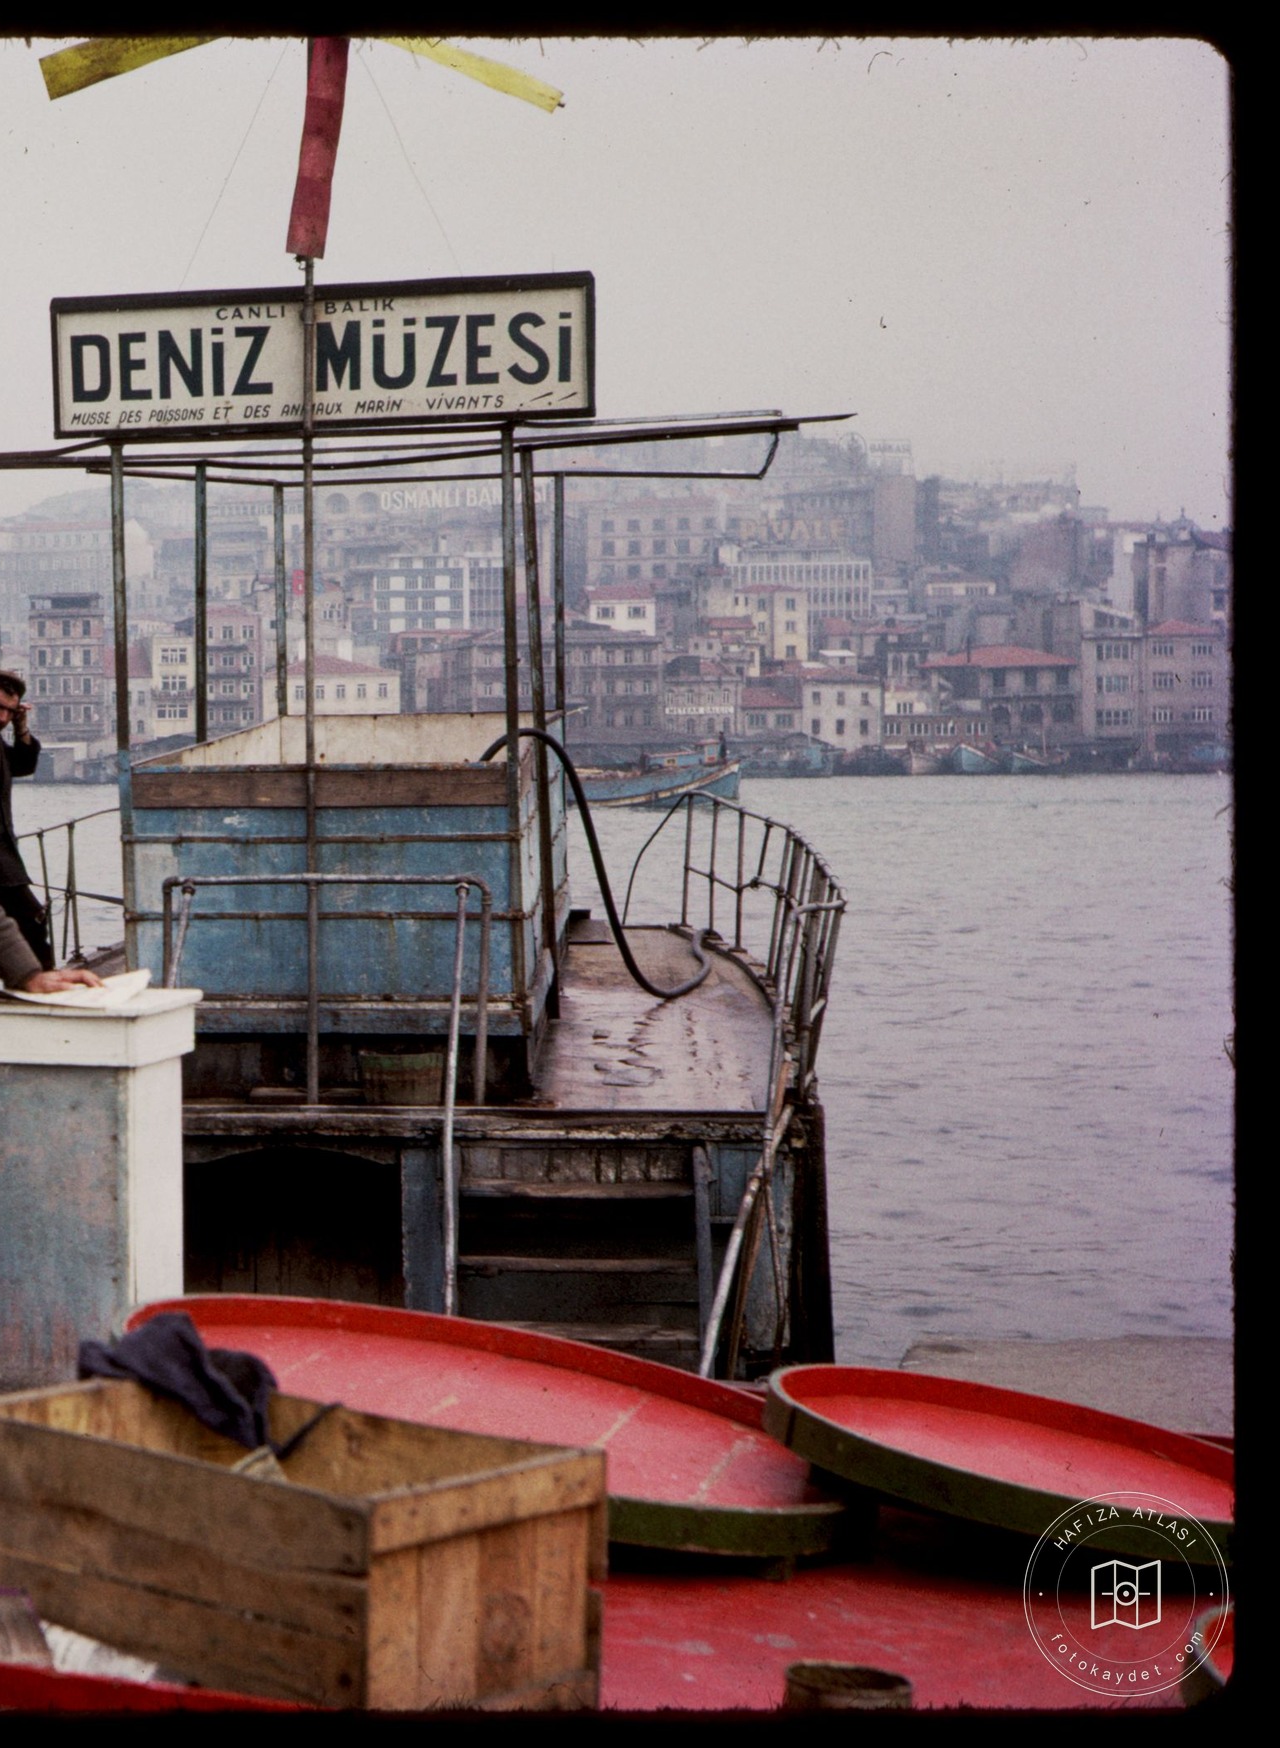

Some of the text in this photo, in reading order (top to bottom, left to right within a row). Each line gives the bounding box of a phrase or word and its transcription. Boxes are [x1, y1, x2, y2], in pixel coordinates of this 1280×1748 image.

[216, 299, 395, 321] CANLI BALIK
[71, 411, 111, 425] MUSSE
[120, 409, 142, 424] DES
[213, 405, 232, 419] ET
[243, 404, 271, 419] DES
[381, 487, 461, 510] OSMANLI
